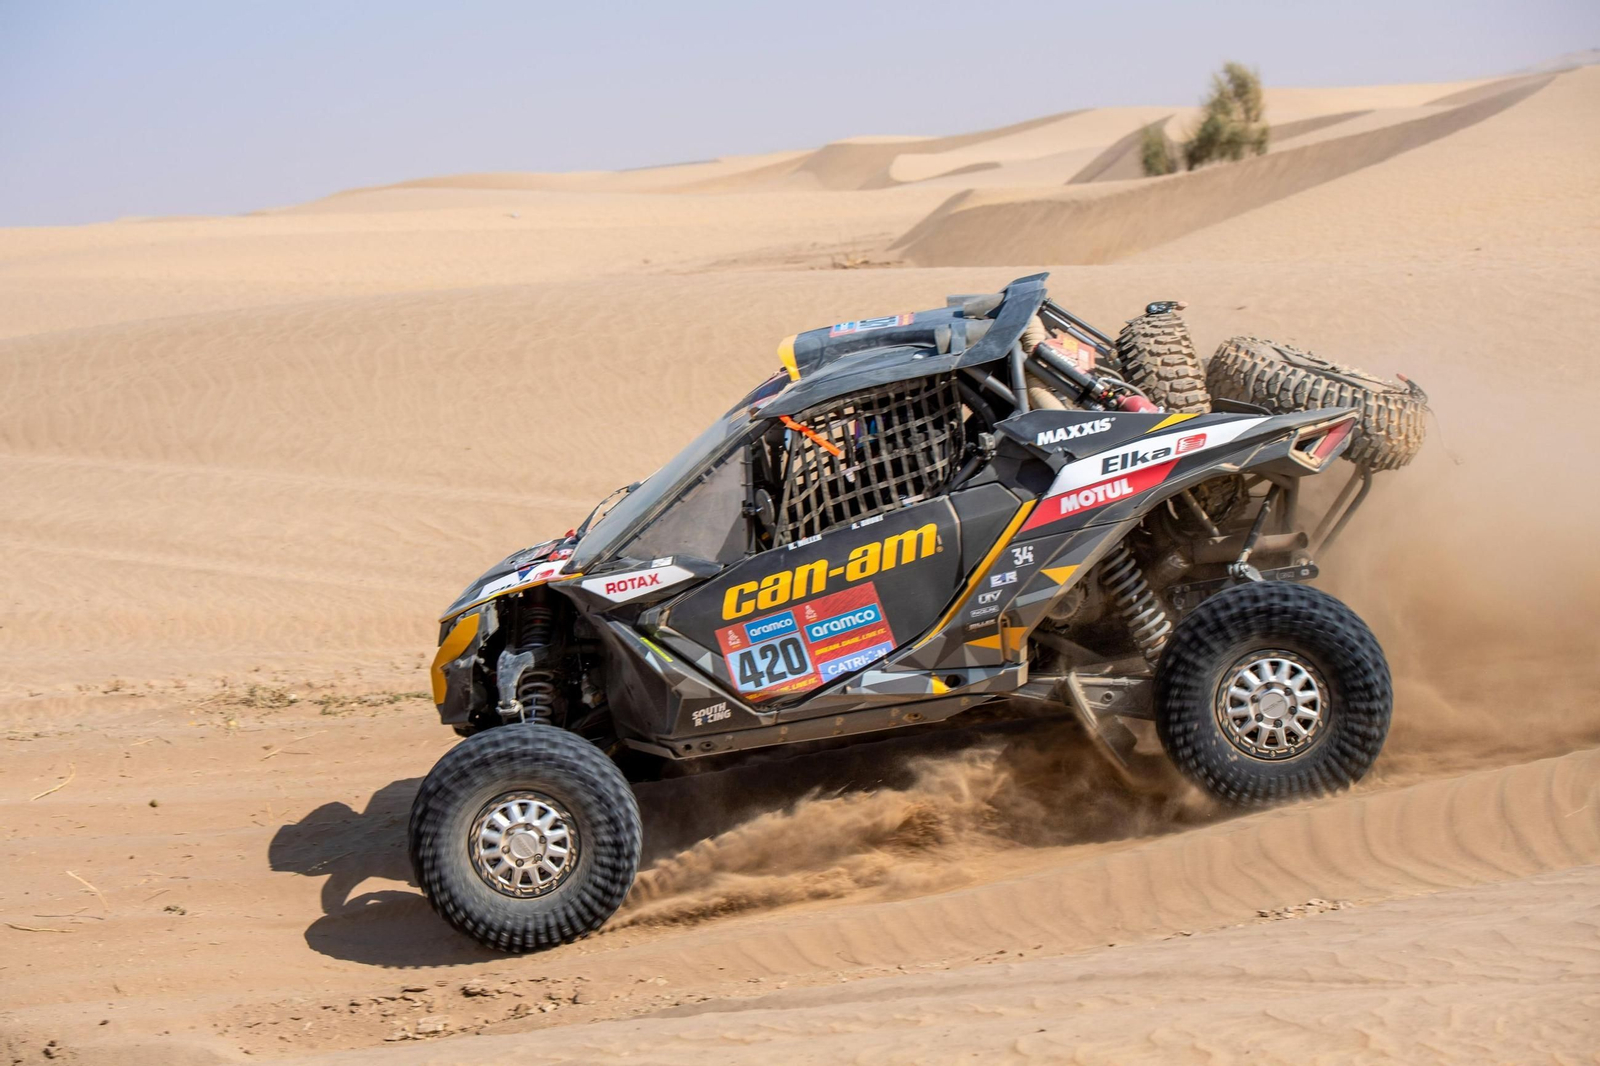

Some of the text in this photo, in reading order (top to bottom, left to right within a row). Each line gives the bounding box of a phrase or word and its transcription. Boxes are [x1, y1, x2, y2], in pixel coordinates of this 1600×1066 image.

[1036, 417, 1113, 446] MAXXIS
[1101, 446, 1172, 475] Elka
[1060, 478, 1134, 515] MOTUL
[605, 573, 661, 595] ROTAX
[722, 523, 938, 621] can-am
[749, 618, 793, 637] aramco
[811, 609, 876, 637] aramco
[739, 637, 808, 688] 420
[692, 701, 727, 720] SOUTH
